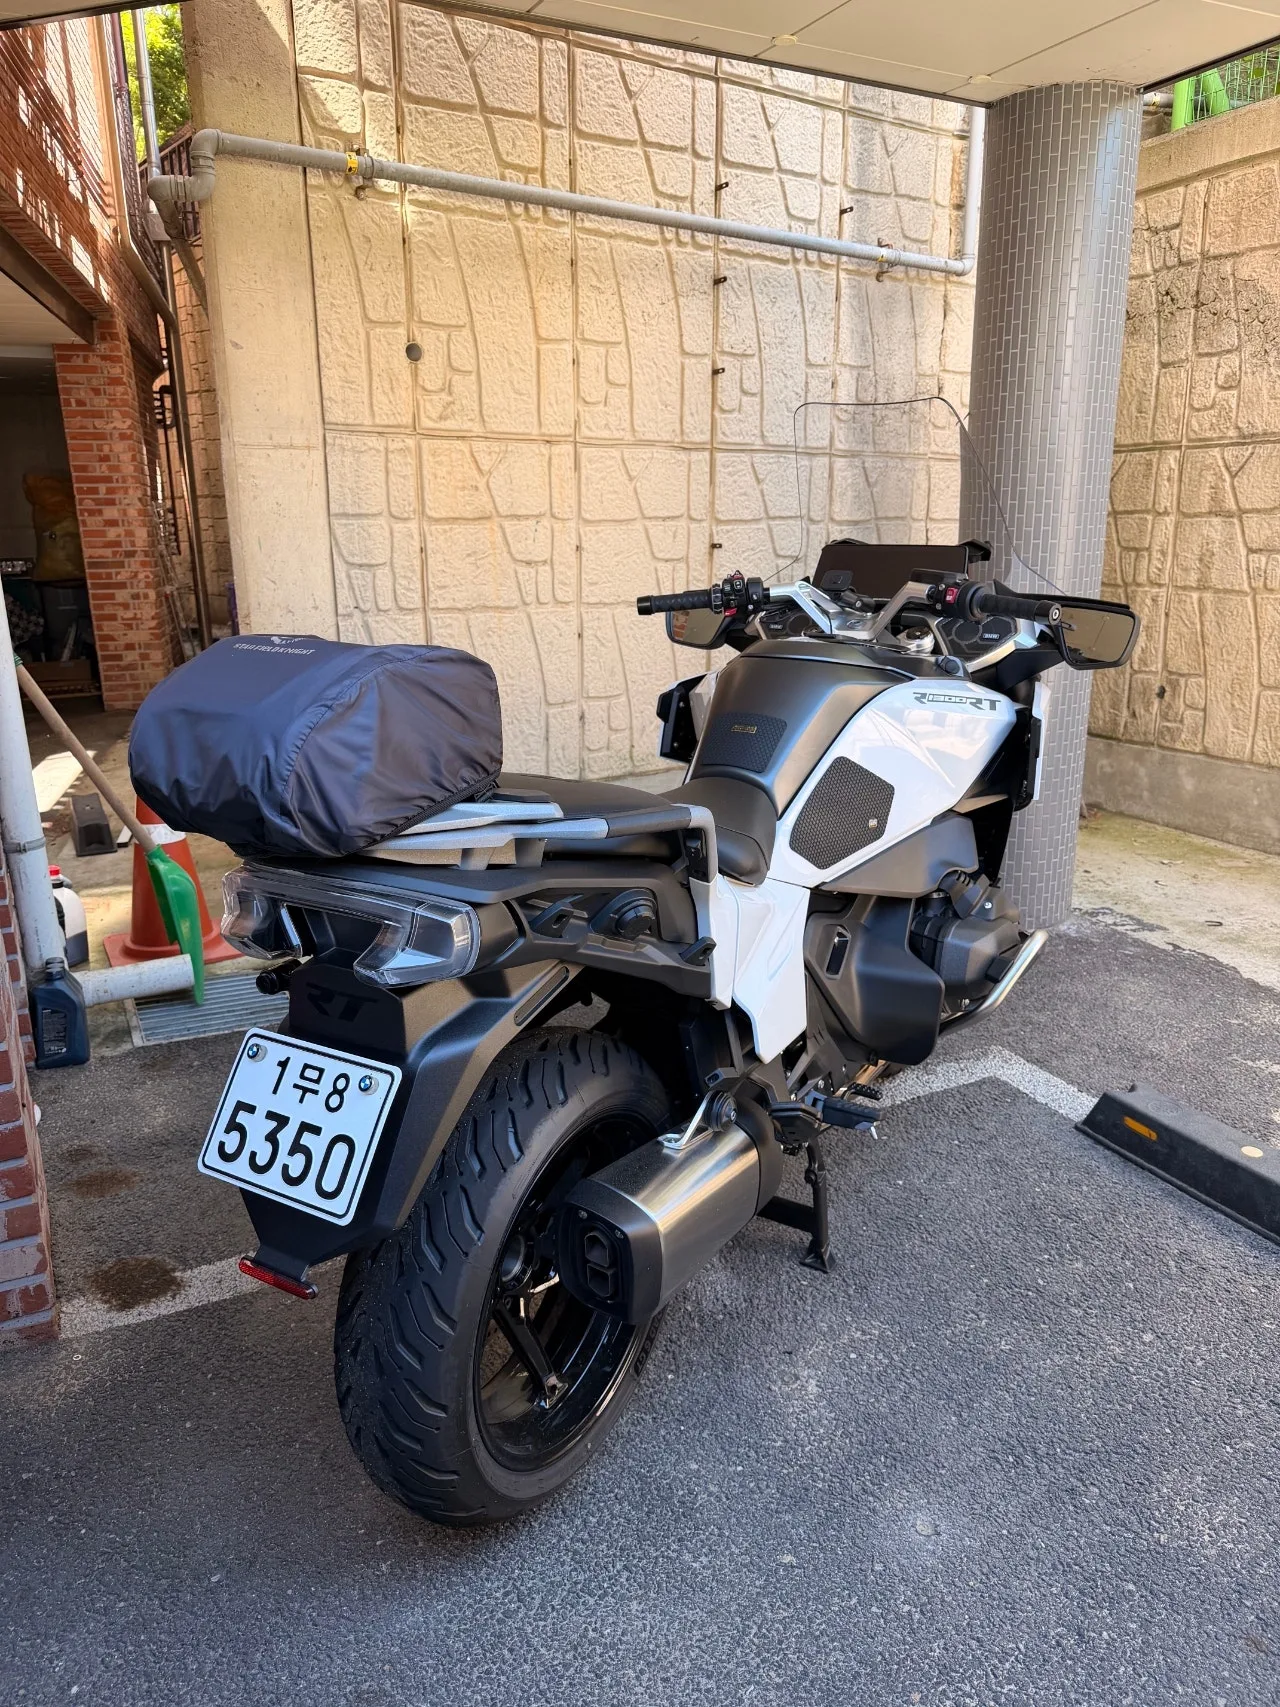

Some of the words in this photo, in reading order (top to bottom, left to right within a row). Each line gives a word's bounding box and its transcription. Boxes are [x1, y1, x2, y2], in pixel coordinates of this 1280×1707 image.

[305, 982, 378, 1022] RT
[272, 1056, 350, 1113] 1무8
[217, 1100, 356, 1200] 5350
